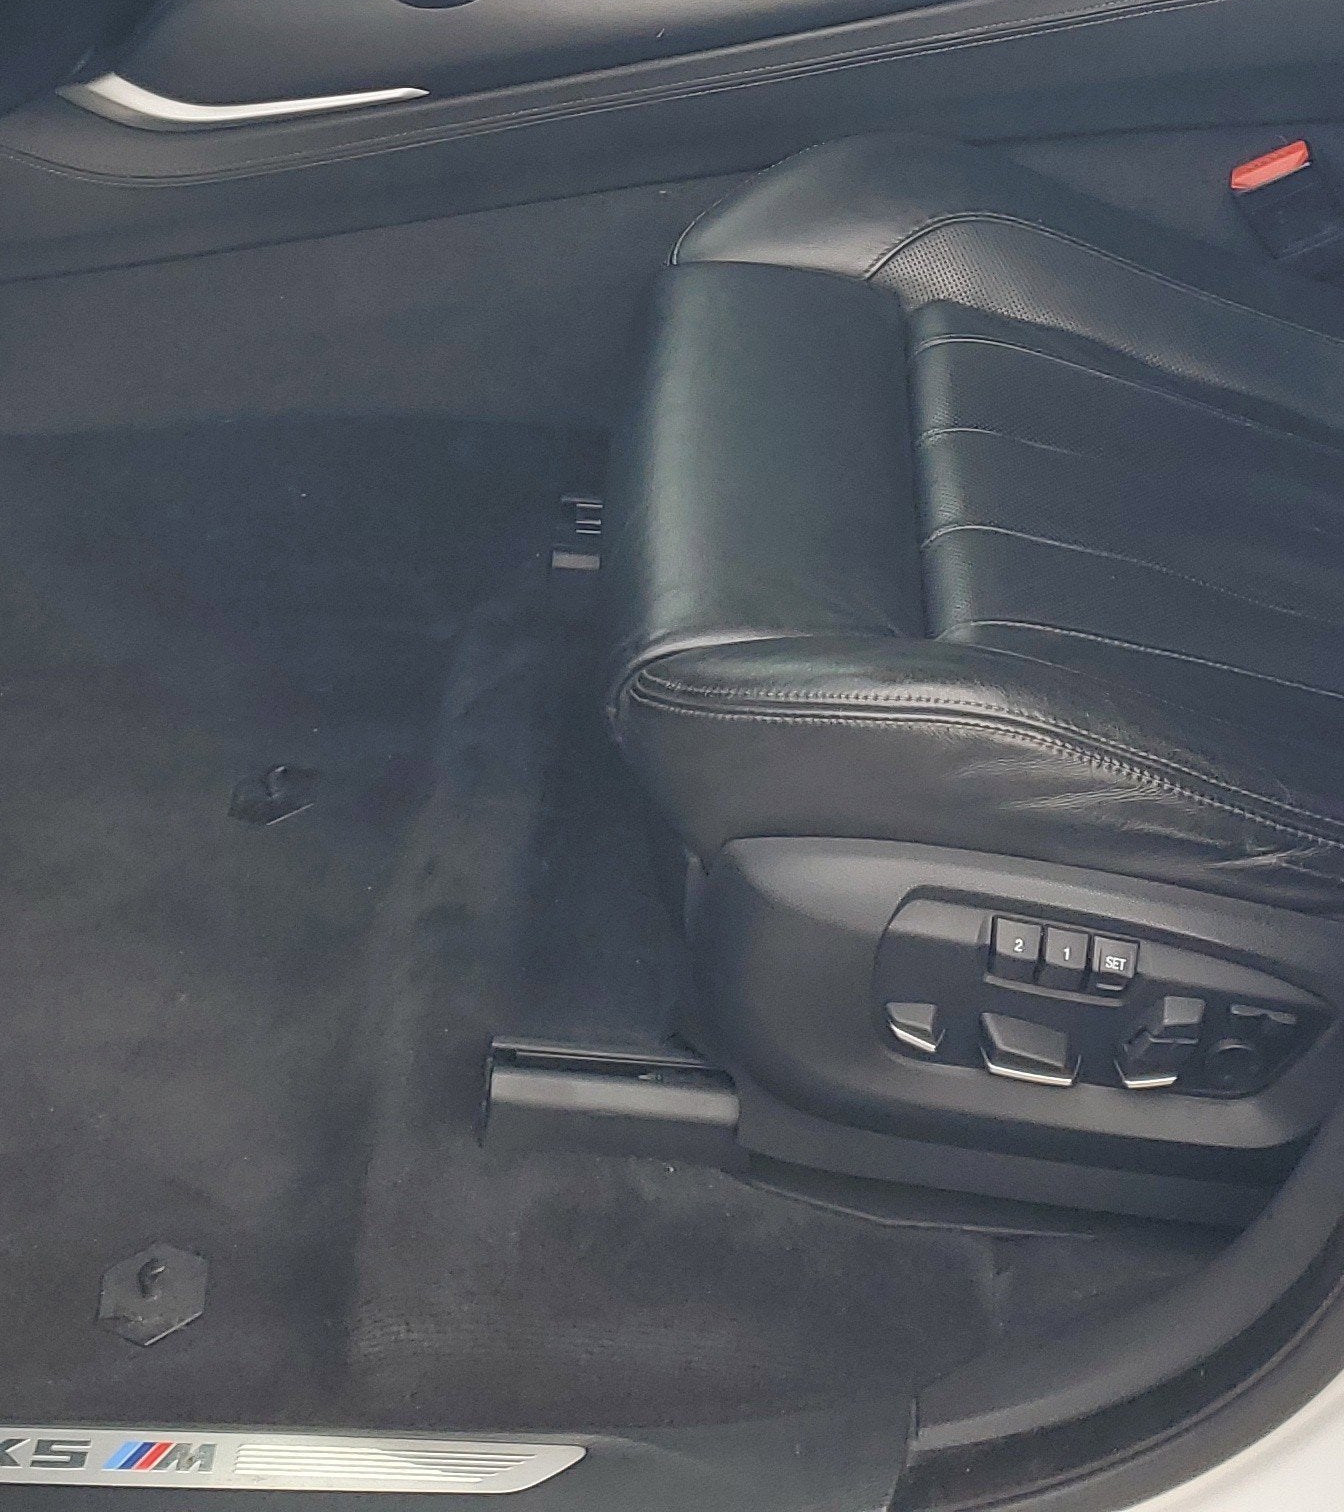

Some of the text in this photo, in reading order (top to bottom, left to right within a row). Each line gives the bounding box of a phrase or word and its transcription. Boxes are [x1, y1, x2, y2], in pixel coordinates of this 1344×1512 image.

[1014, 938, 1024, 952] 2
[1063, 947, 1071, 961] 1
[1105, 955, 1127, 971] SET
